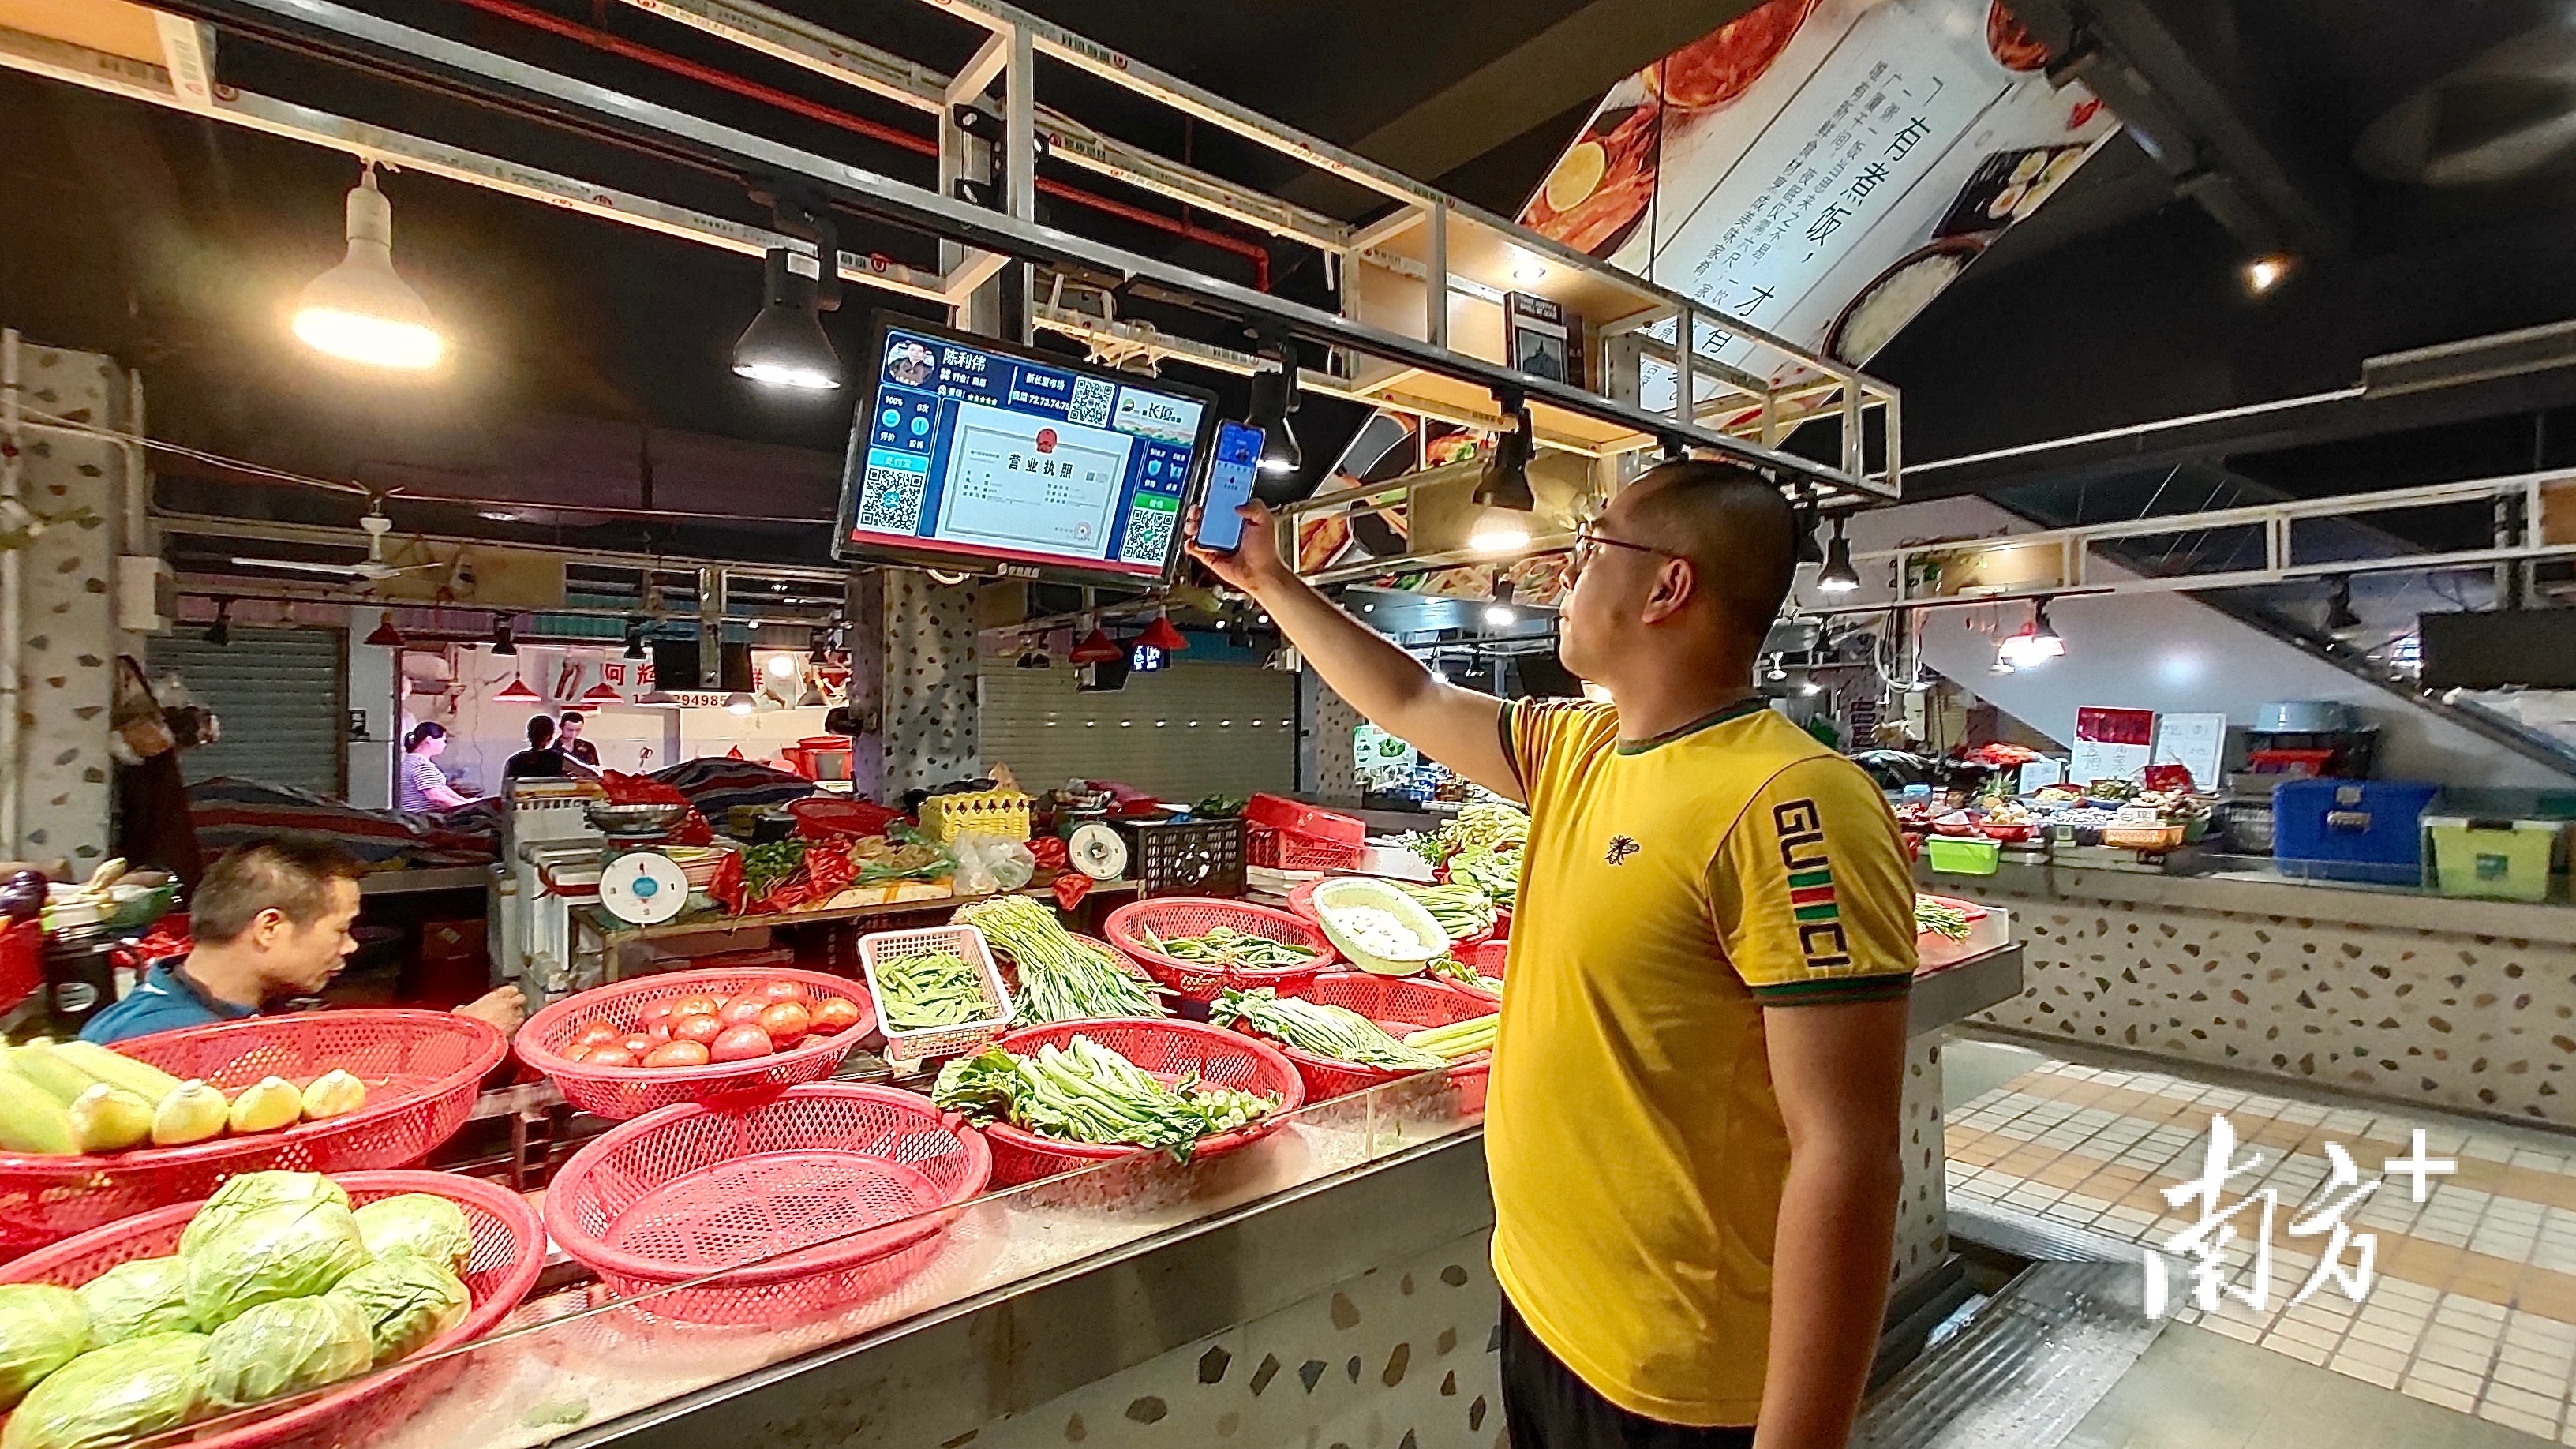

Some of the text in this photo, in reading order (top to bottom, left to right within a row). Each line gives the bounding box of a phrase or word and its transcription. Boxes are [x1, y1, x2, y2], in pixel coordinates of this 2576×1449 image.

[942, 348, 987, 372] 陈利伟
[885, 395, 904, 406] 100%
[1009, 454, 1073, 479] 营业执照
